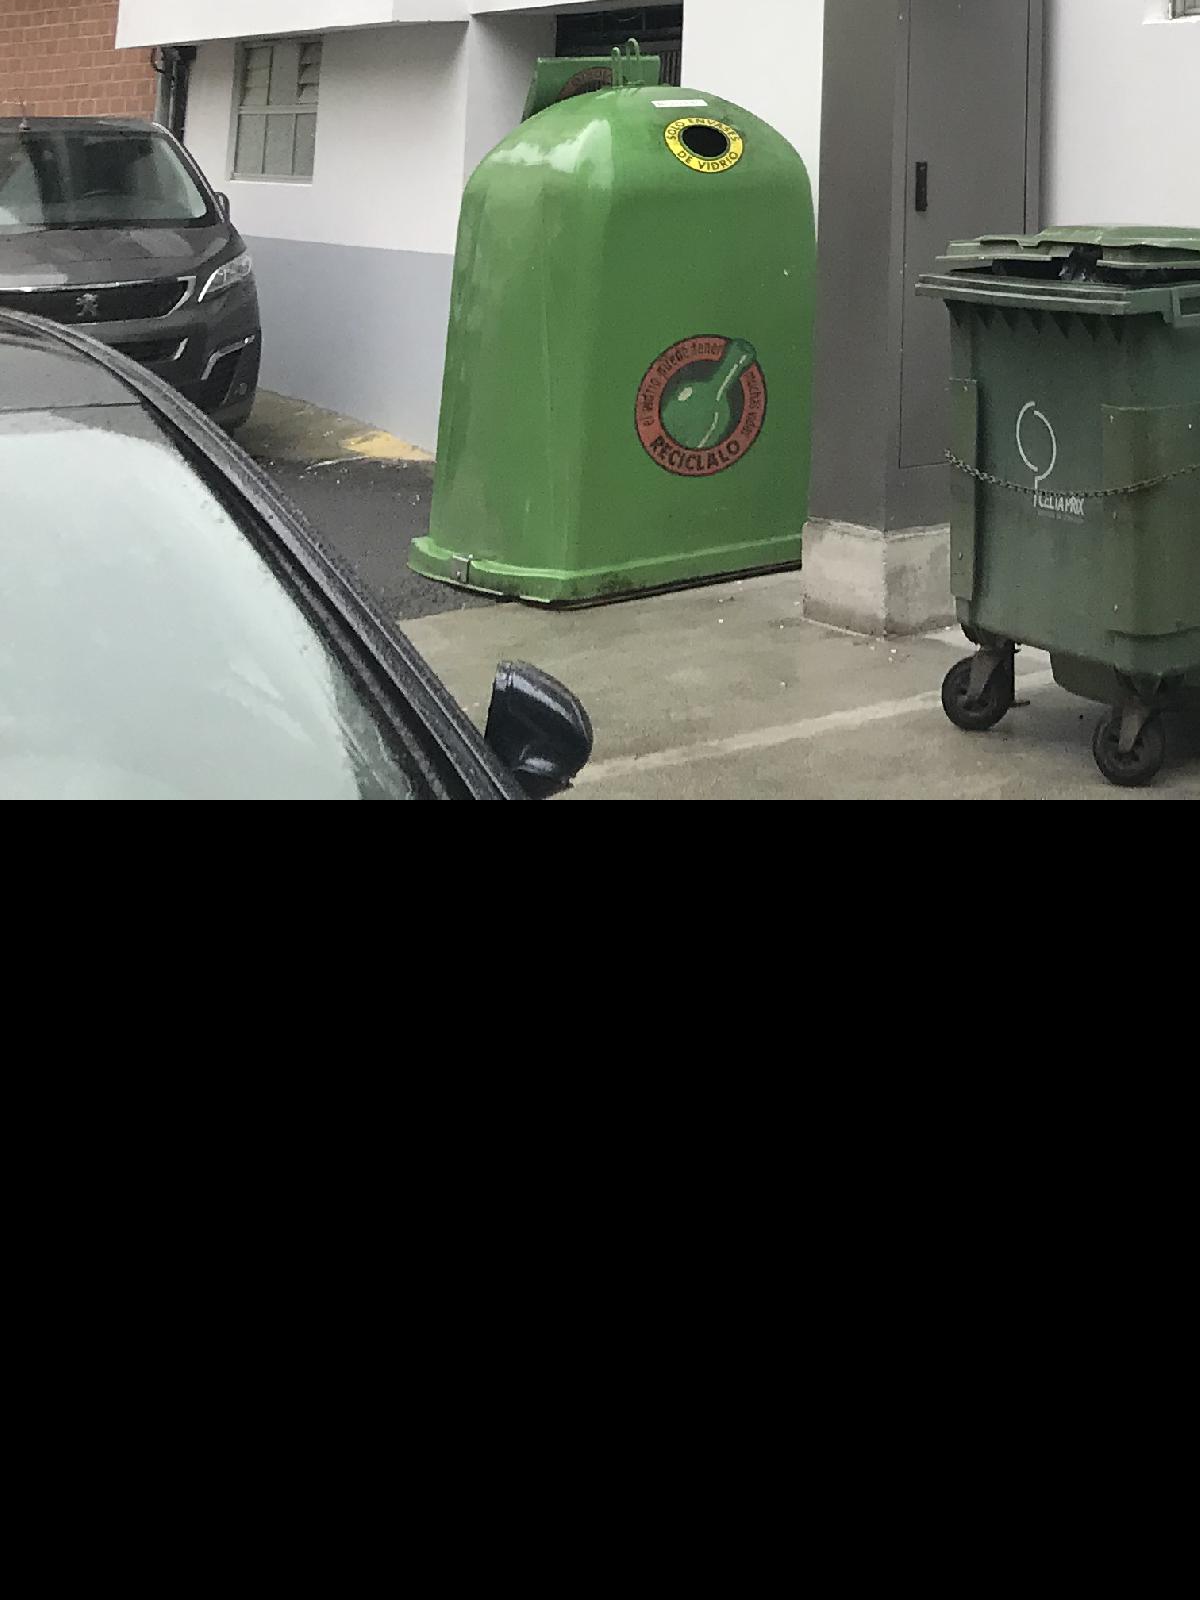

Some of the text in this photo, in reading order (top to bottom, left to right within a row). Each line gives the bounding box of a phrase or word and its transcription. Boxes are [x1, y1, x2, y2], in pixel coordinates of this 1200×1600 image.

[666, 118, 740, 142] SOLO ENVASES
[677, 150, 738, 171] DE VIDRIO
[649, 435, 740, 471] RECICLALO
